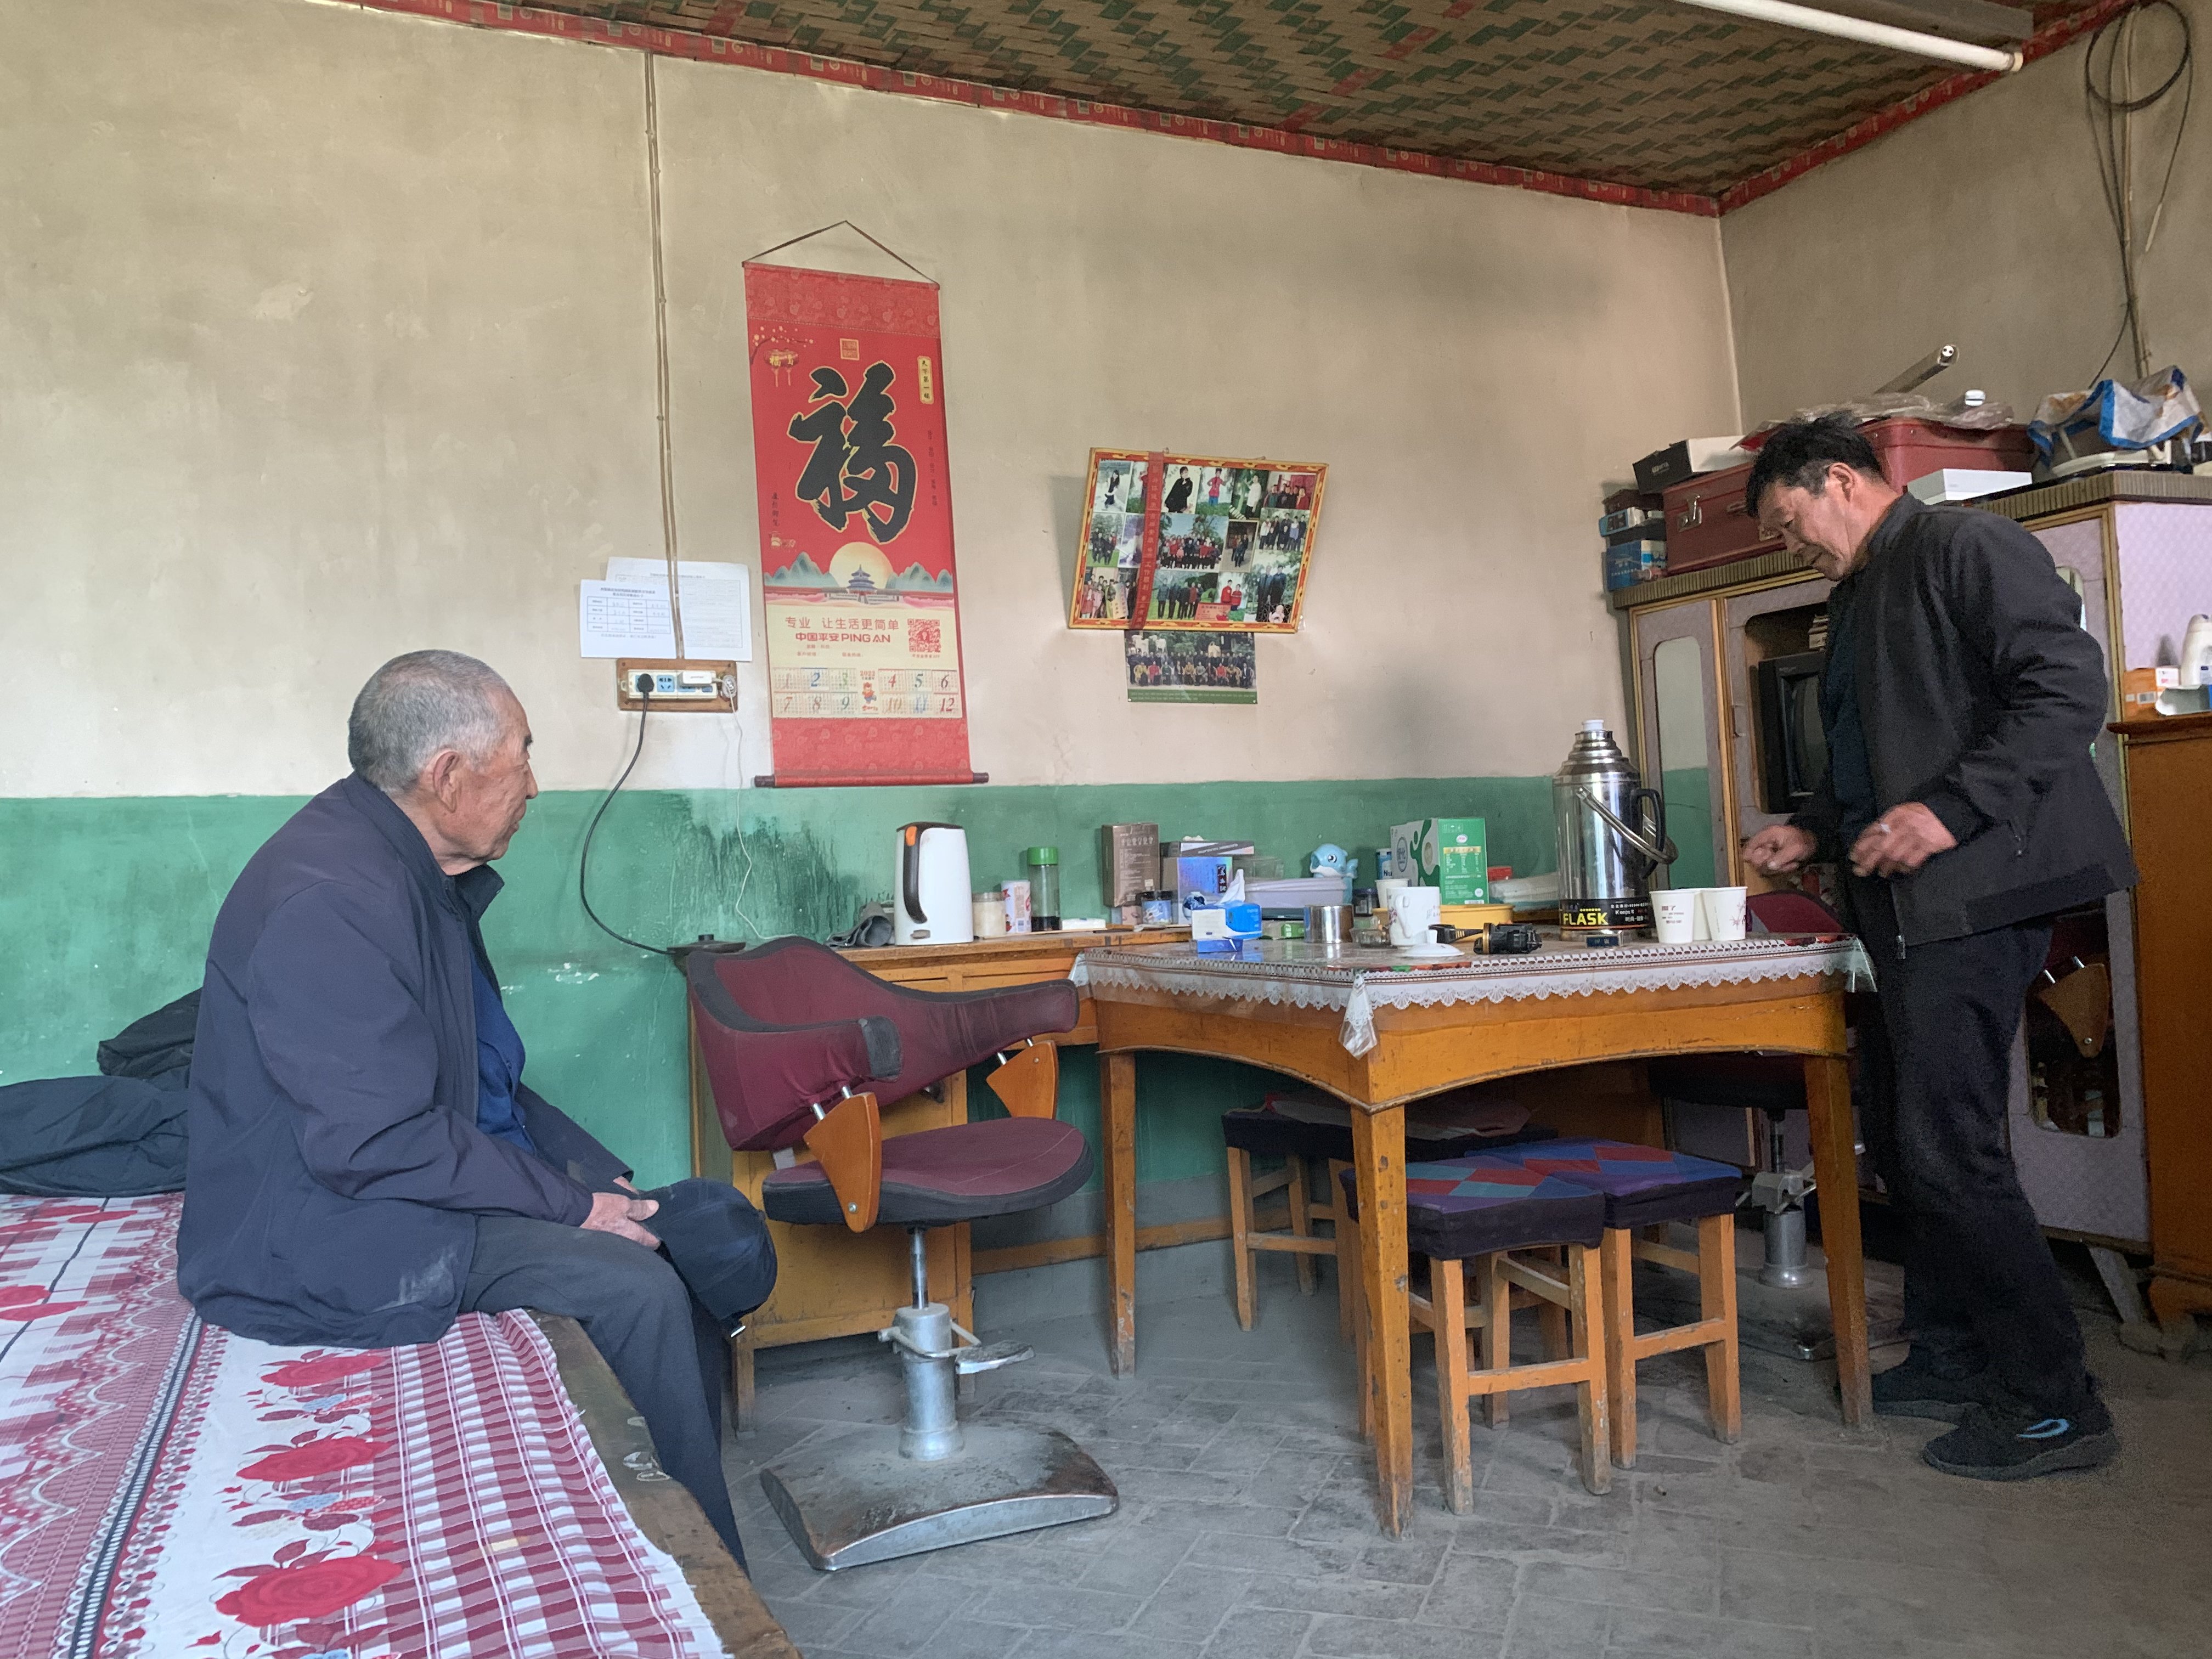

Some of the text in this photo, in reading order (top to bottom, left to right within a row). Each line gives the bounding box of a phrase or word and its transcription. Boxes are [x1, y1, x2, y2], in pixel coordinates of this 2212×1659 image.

[787, 360, 918, 544] 福
[785, 616, 900, 631] 专业 让生活更简单
[795, 632, 839, 642] 中国平安
[811, 673, 821, 687] 2
[888, 674, 896, 688] 4
[915, 673, 923, 688] 5
[940, 674, 950, 689] 6
[785, 696, 793, 712] 7
[812, 696, 822, 711] 8
[841, 696, 850, 710] 9
[940, 698, 955, 712] 12
[1563, 912, 1609, 926] FLASK
